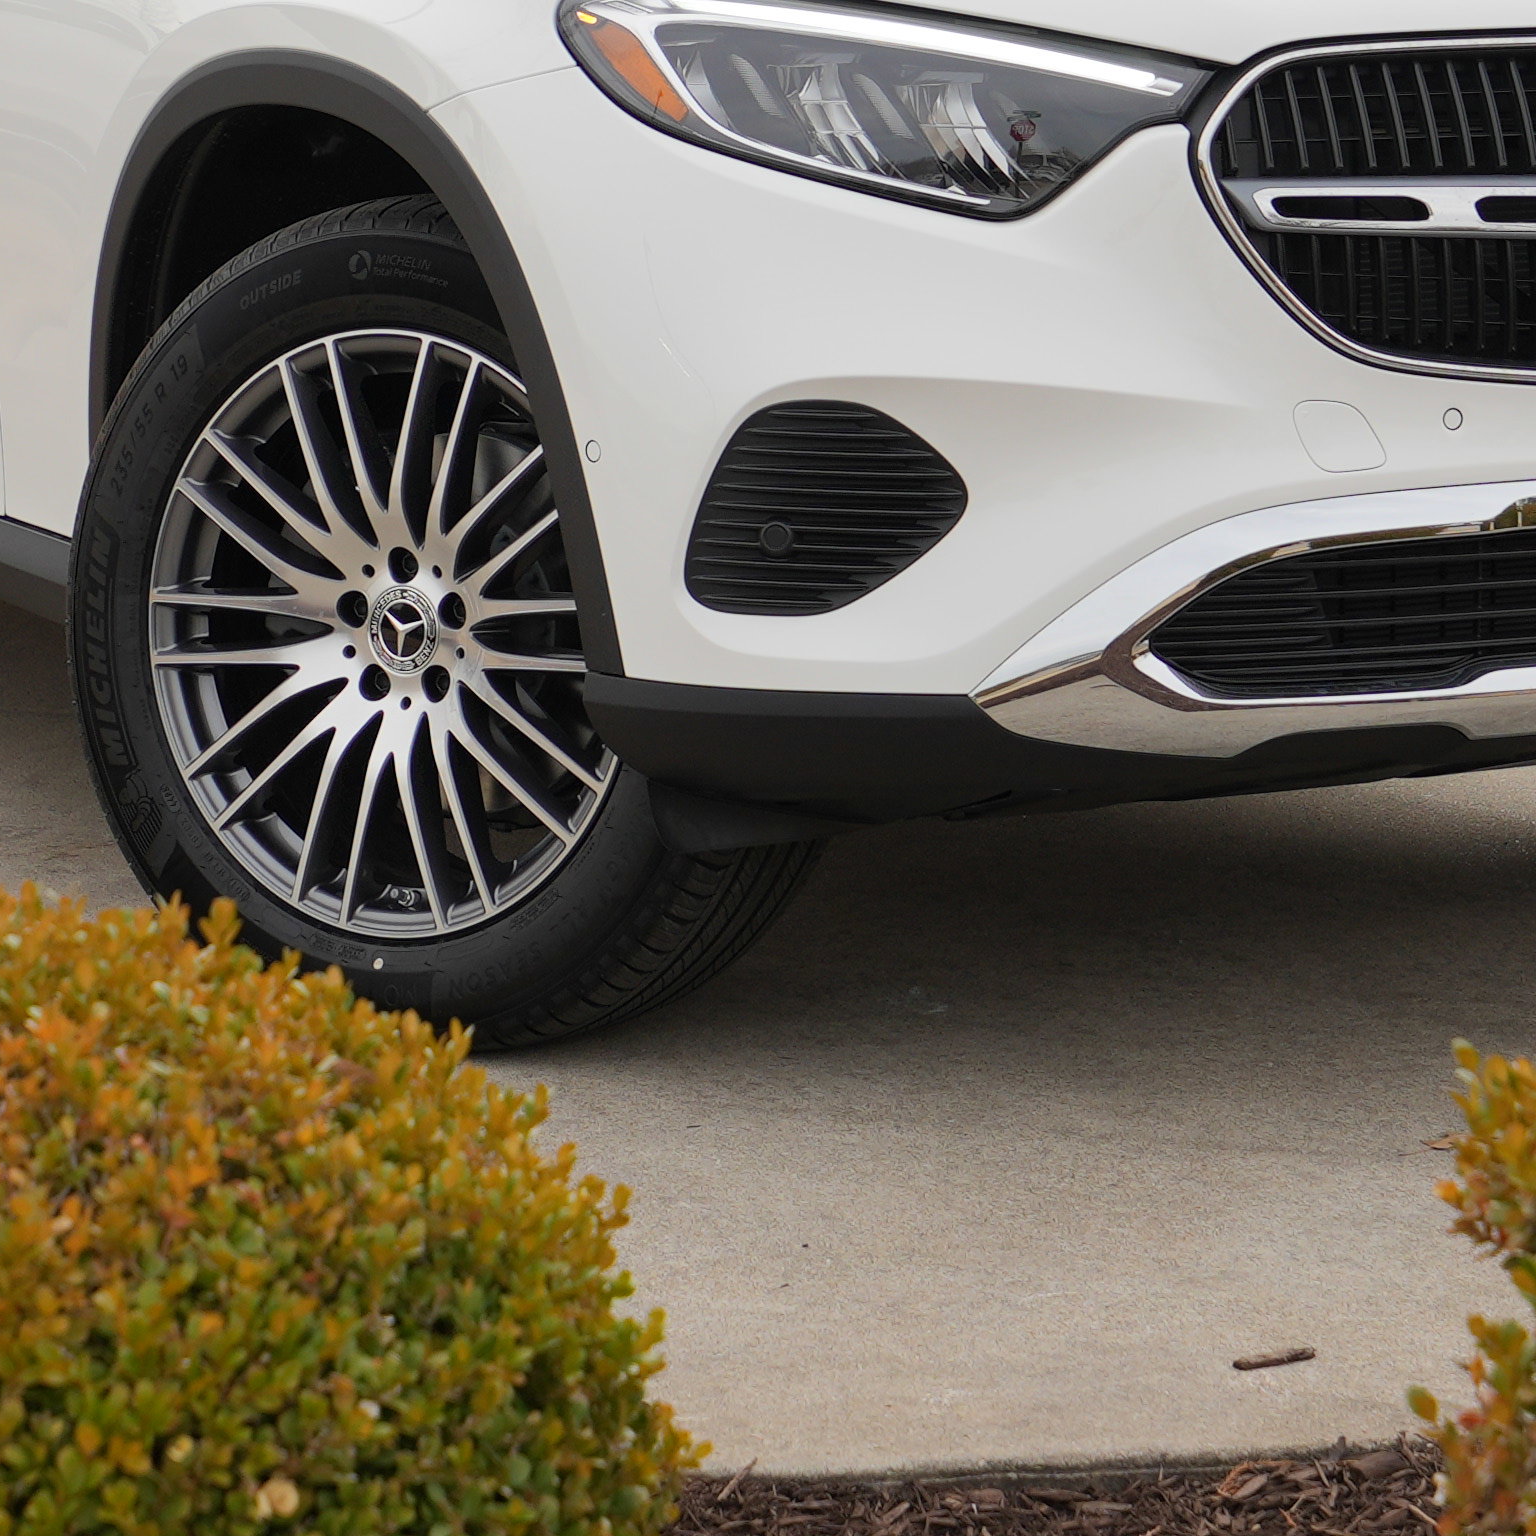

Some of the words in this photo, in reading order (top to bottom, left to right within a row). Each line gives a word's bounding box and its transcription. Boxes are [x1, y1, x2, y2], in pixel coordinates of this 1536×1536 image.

[375, 253, 431, 270] MICHELIN
[394, 269, 449, 288] Performance
[240, 269, 302, 310] OUTSIDE
[155, 382, 168, 403] R
[170, 354, 188, 381] 19
[84, 526, 131, 767] MICHELIN
